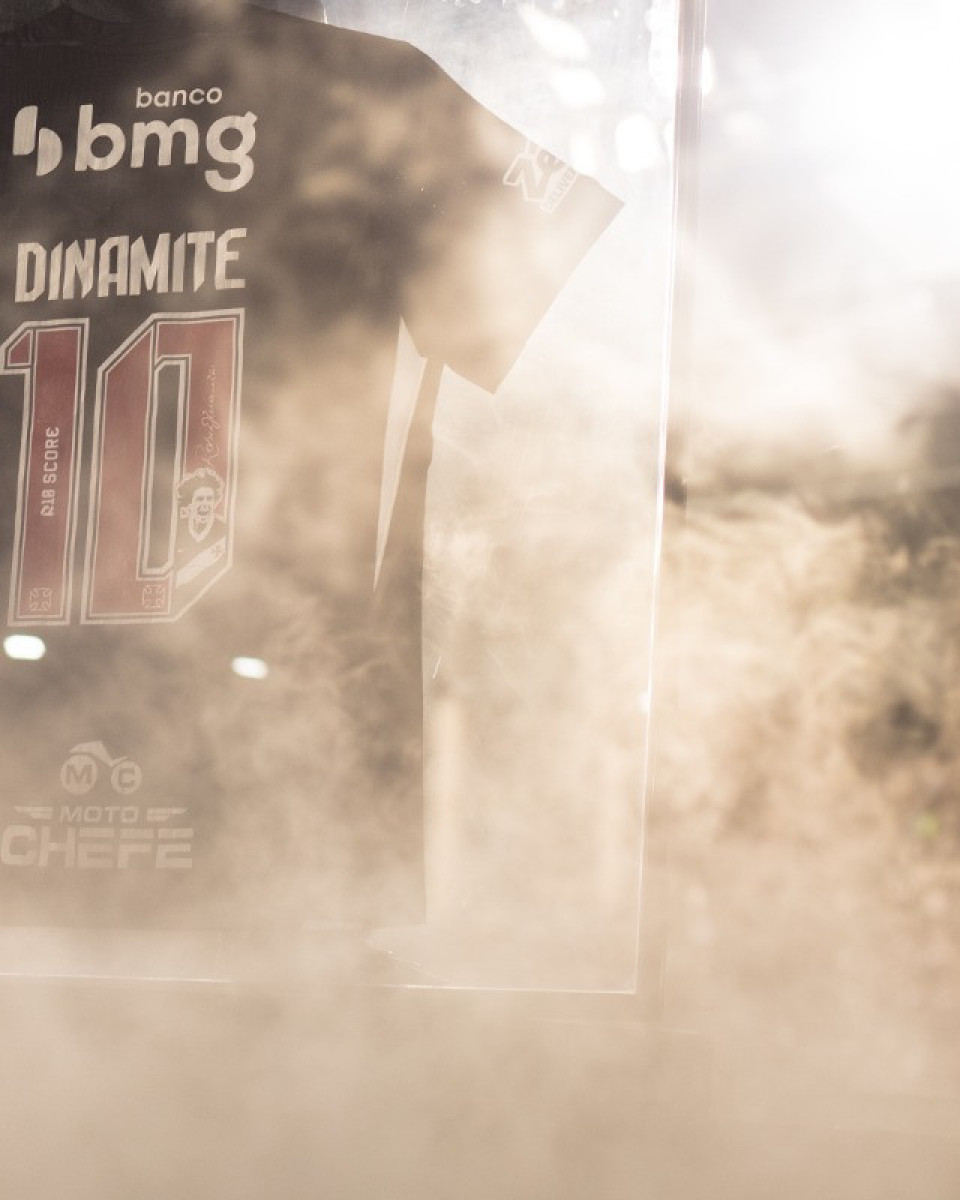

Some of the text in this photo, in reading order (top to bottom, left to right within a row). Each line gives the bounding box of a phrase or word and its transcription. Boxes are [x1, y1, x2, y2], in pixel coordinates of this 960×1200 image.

[136, 86, 223, 109] banco
[74, 104, 258, 192] bmg
[14, 227, 247, 303] DINAMITE
[42, 427, 60, 484] SCORE
[60, 805, 140, 823] MOTO
[0, 824, 194, 869] CHEFE
